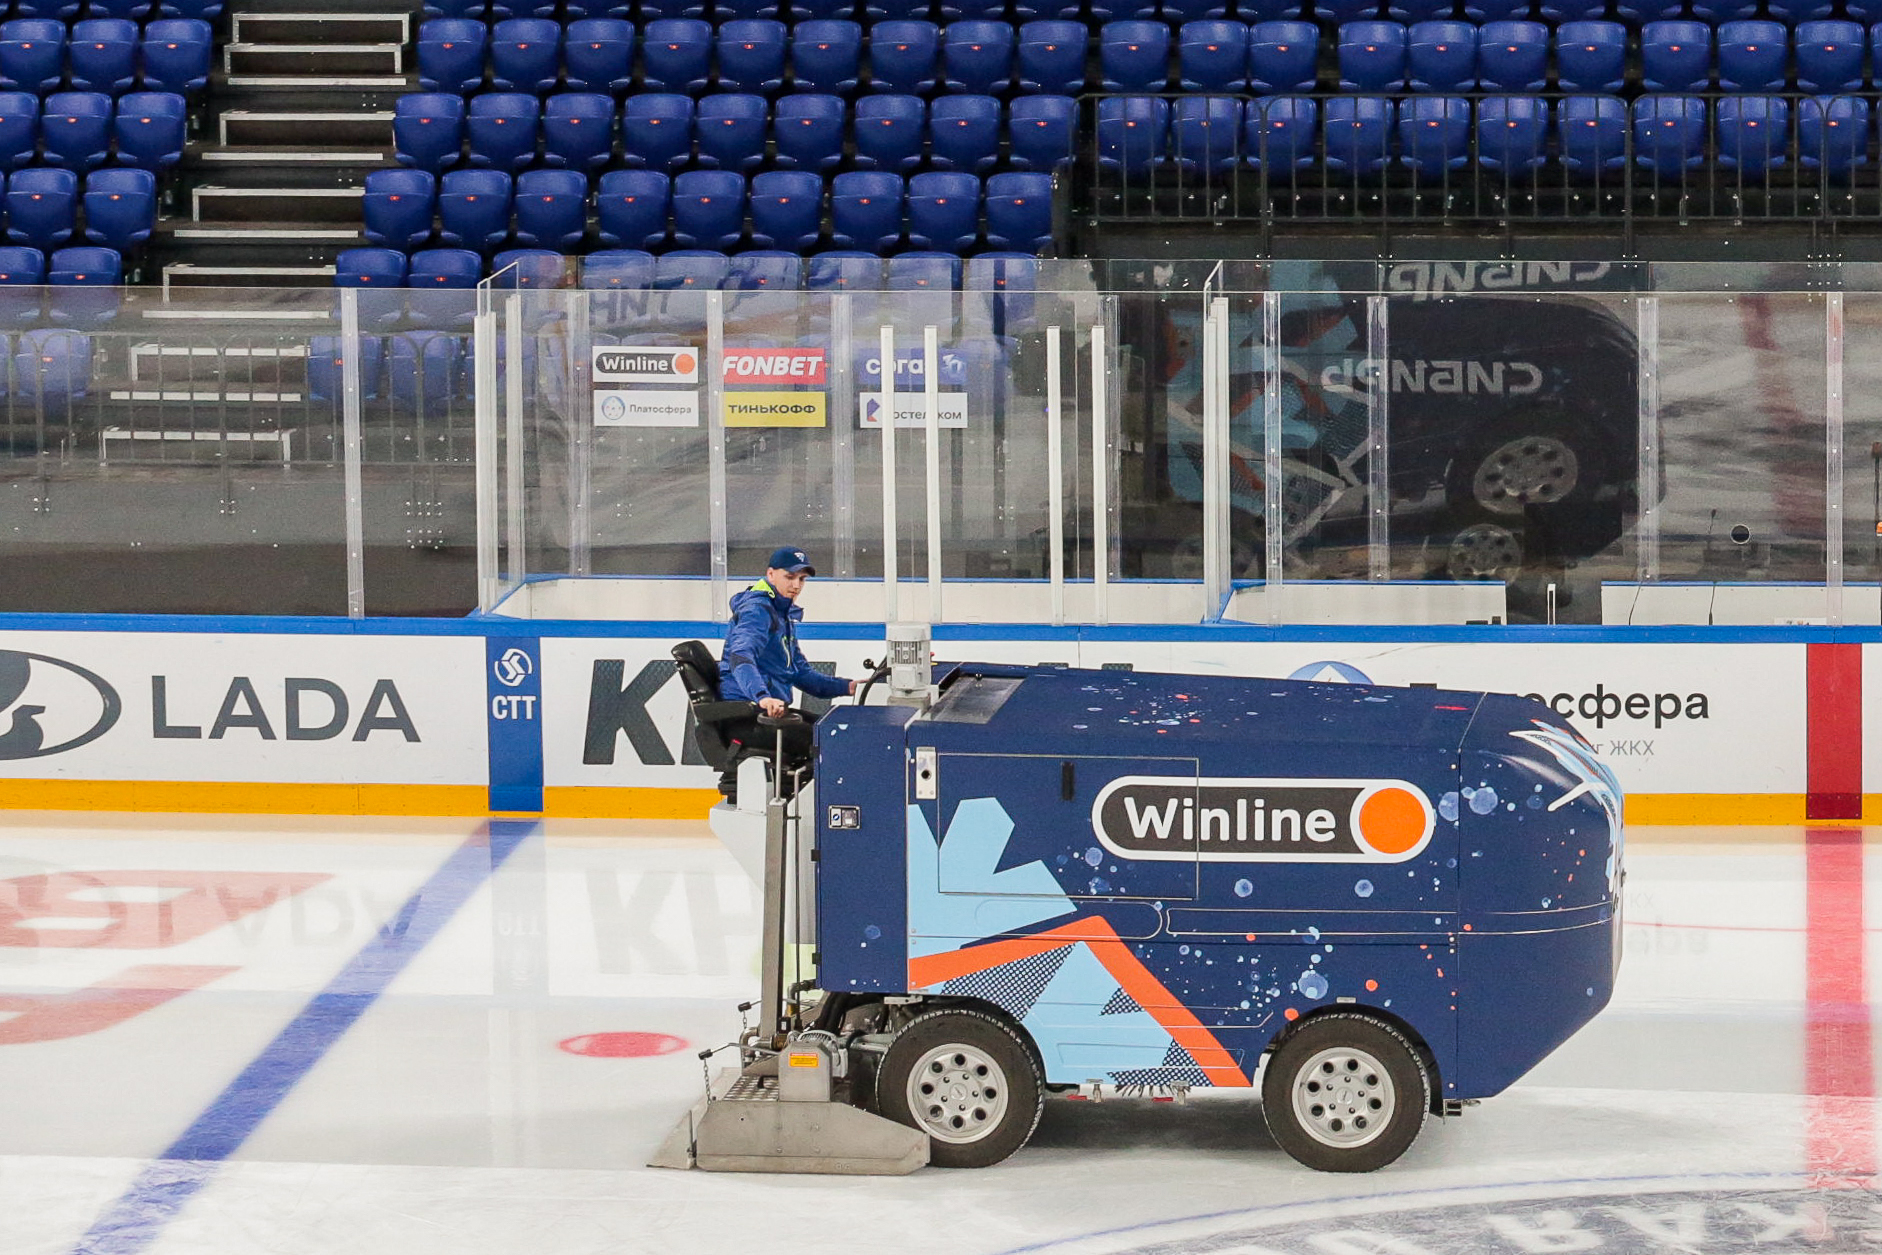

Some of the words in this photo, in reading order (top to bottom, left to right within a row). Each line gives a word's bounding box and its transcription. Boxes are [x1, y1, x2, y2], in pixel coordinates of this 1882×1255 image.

[602, 356, 669, 372] Winline
[724, 356, 822, 376] FONBET
[629, 403, 692, 416] Платосфера
[728, 404, 816, 414] ТИНЬКОФФ
[152, 675, 421, 743] LADA
[1609, 740, 1655, 756] ЖКХ
[1124, 796, 1337, 842] Winline
